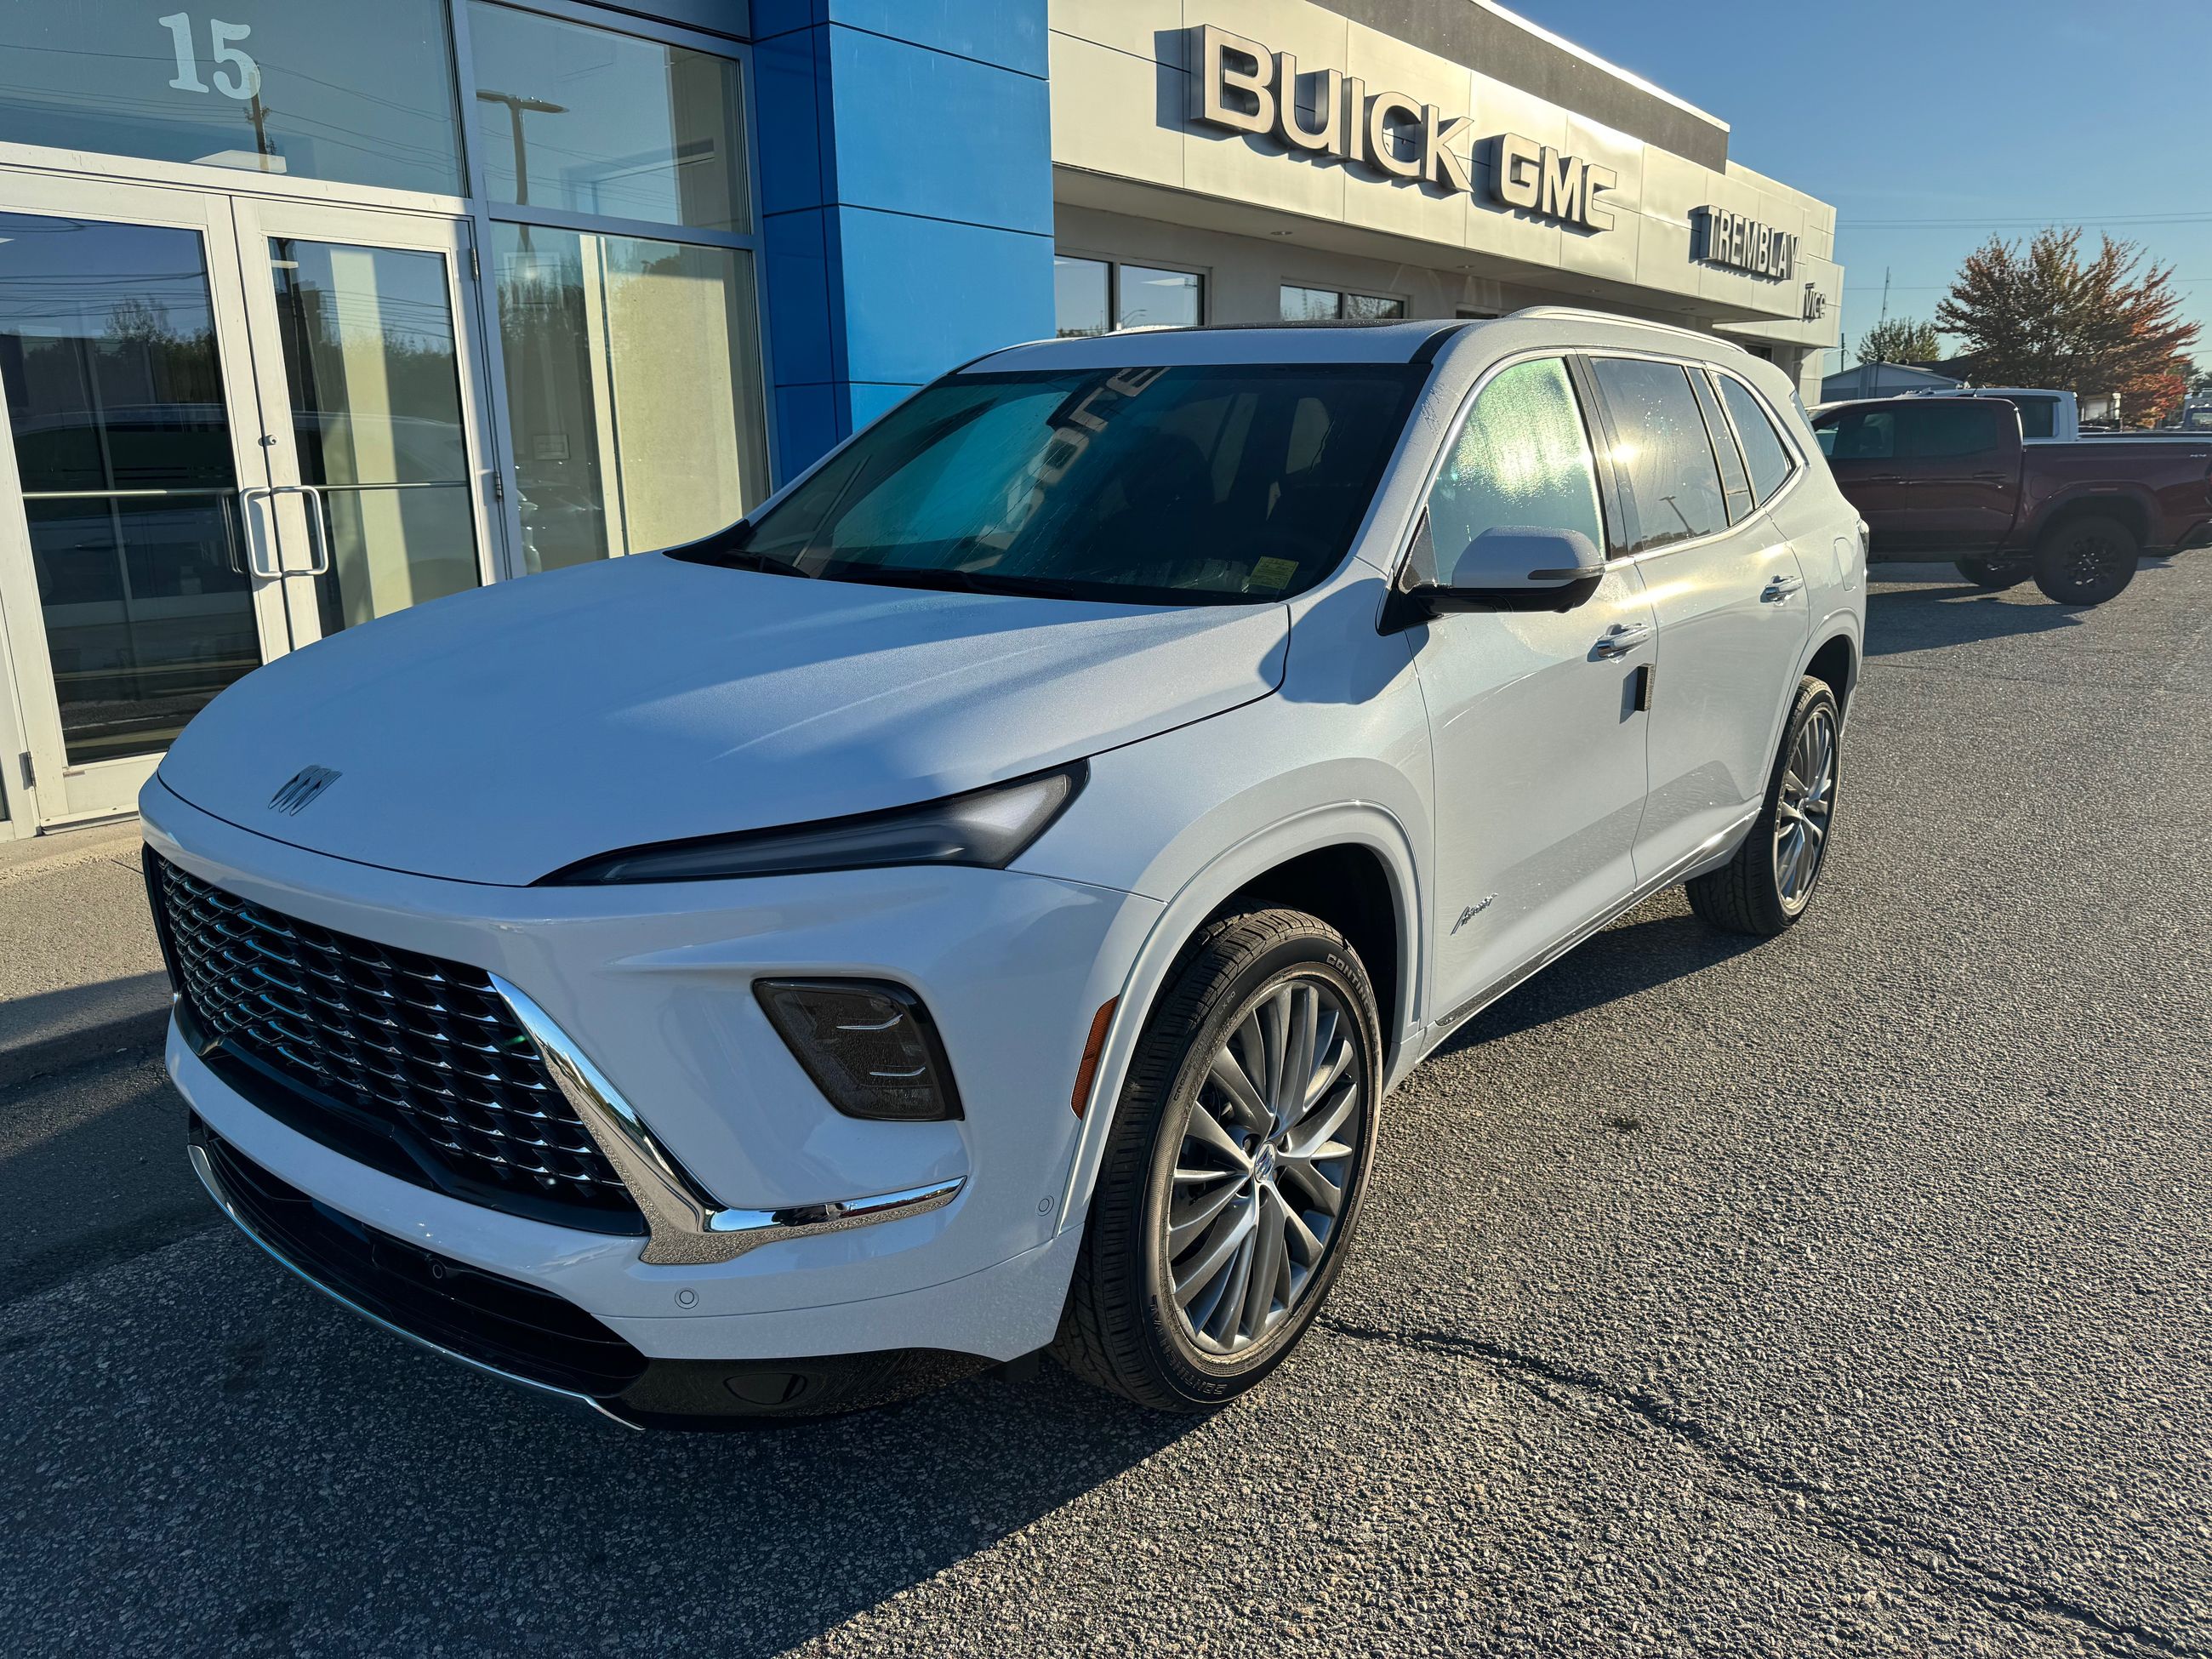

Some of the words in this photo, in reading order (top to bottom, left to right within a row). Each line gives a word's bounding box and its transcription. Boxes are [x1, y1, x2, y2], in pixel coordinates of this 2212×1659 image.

[158, 12, 261, 100] 15
[1194, 24, 1474, 192] BUICK
[1499, 132, 1617, 231] GMC
[1705, 204, 1801, 280] TREMBLAY
